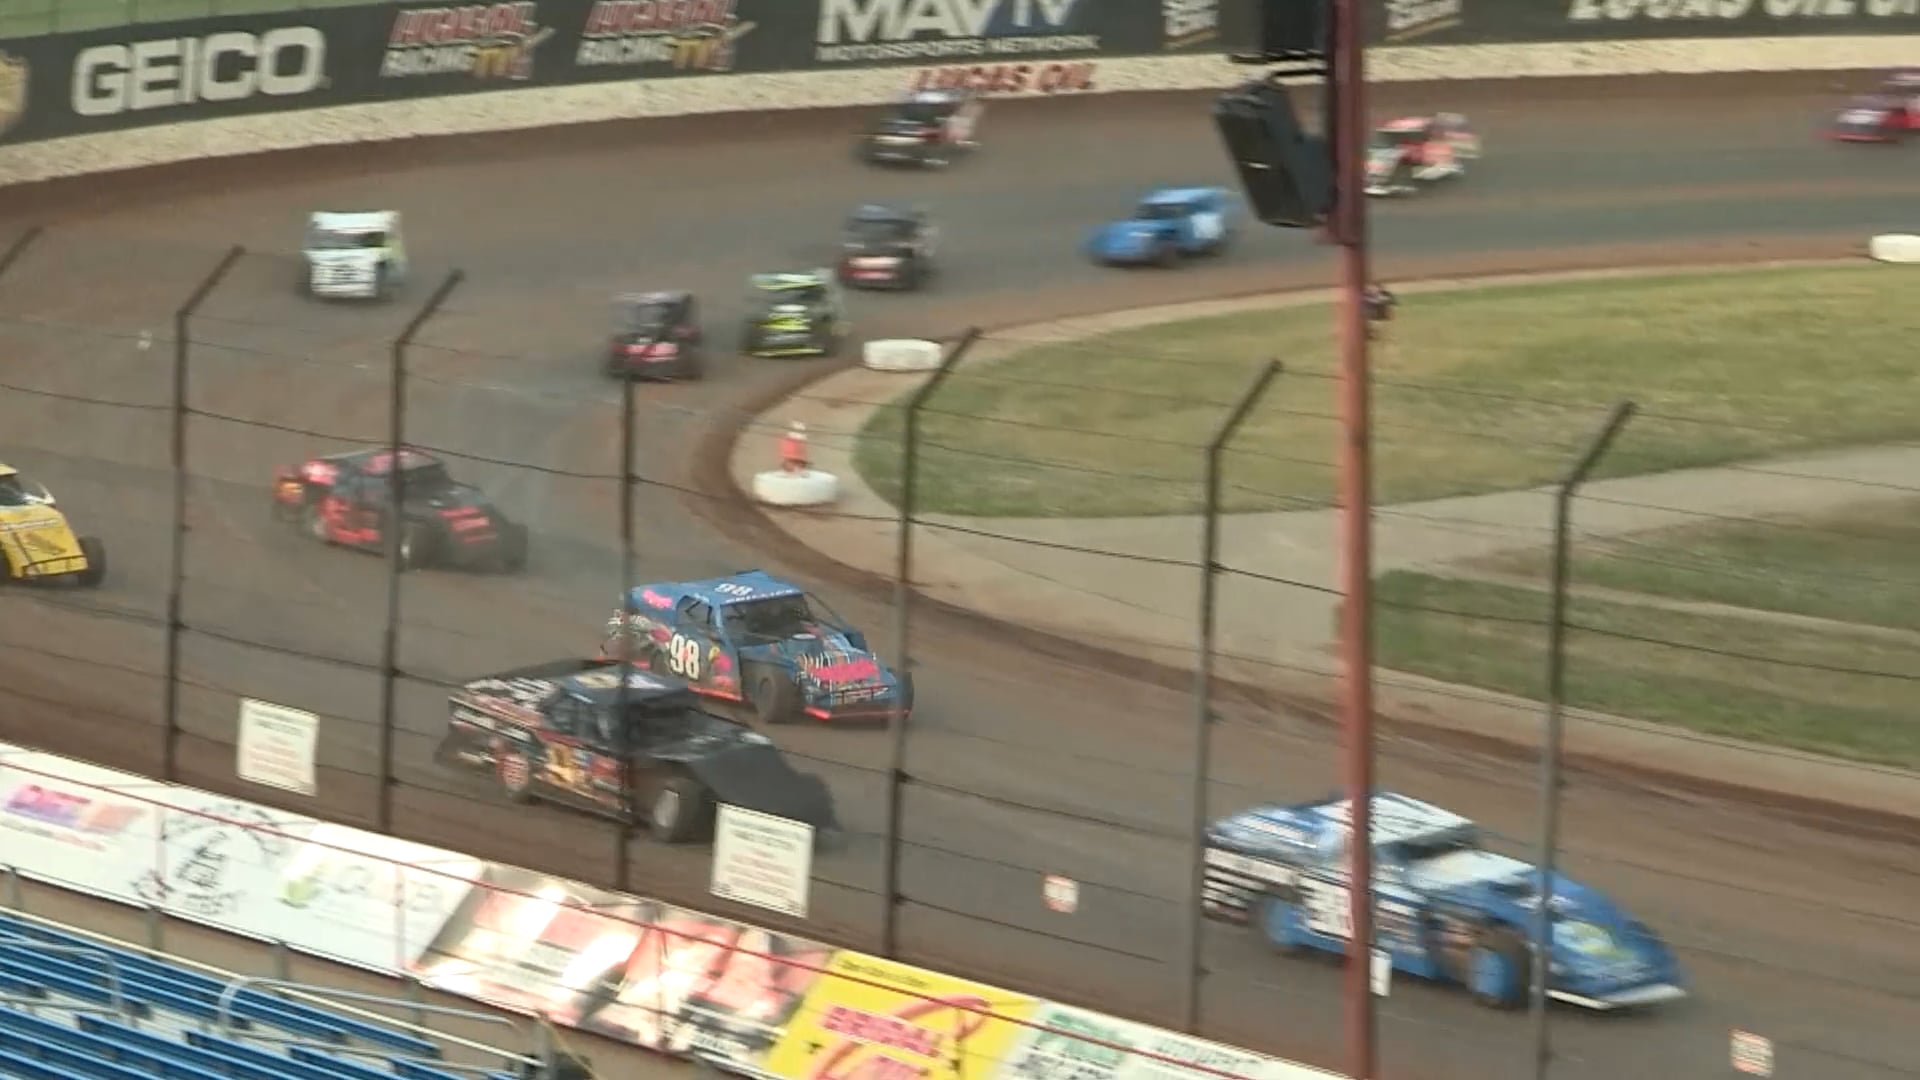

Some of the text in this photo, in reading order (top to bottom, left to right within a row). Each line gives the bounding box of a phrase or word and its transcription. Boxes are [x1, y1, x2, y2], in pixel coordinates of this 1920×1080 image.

[814, 35, 1100, 61] MOTORSPORTS NETWORK
[72, 27, 326, 116] GEICO
[914, 62, 1096, 93] LUCAS OIL
[714, 583, 753, 596] 98
[669, 632, 700, 681] 98
